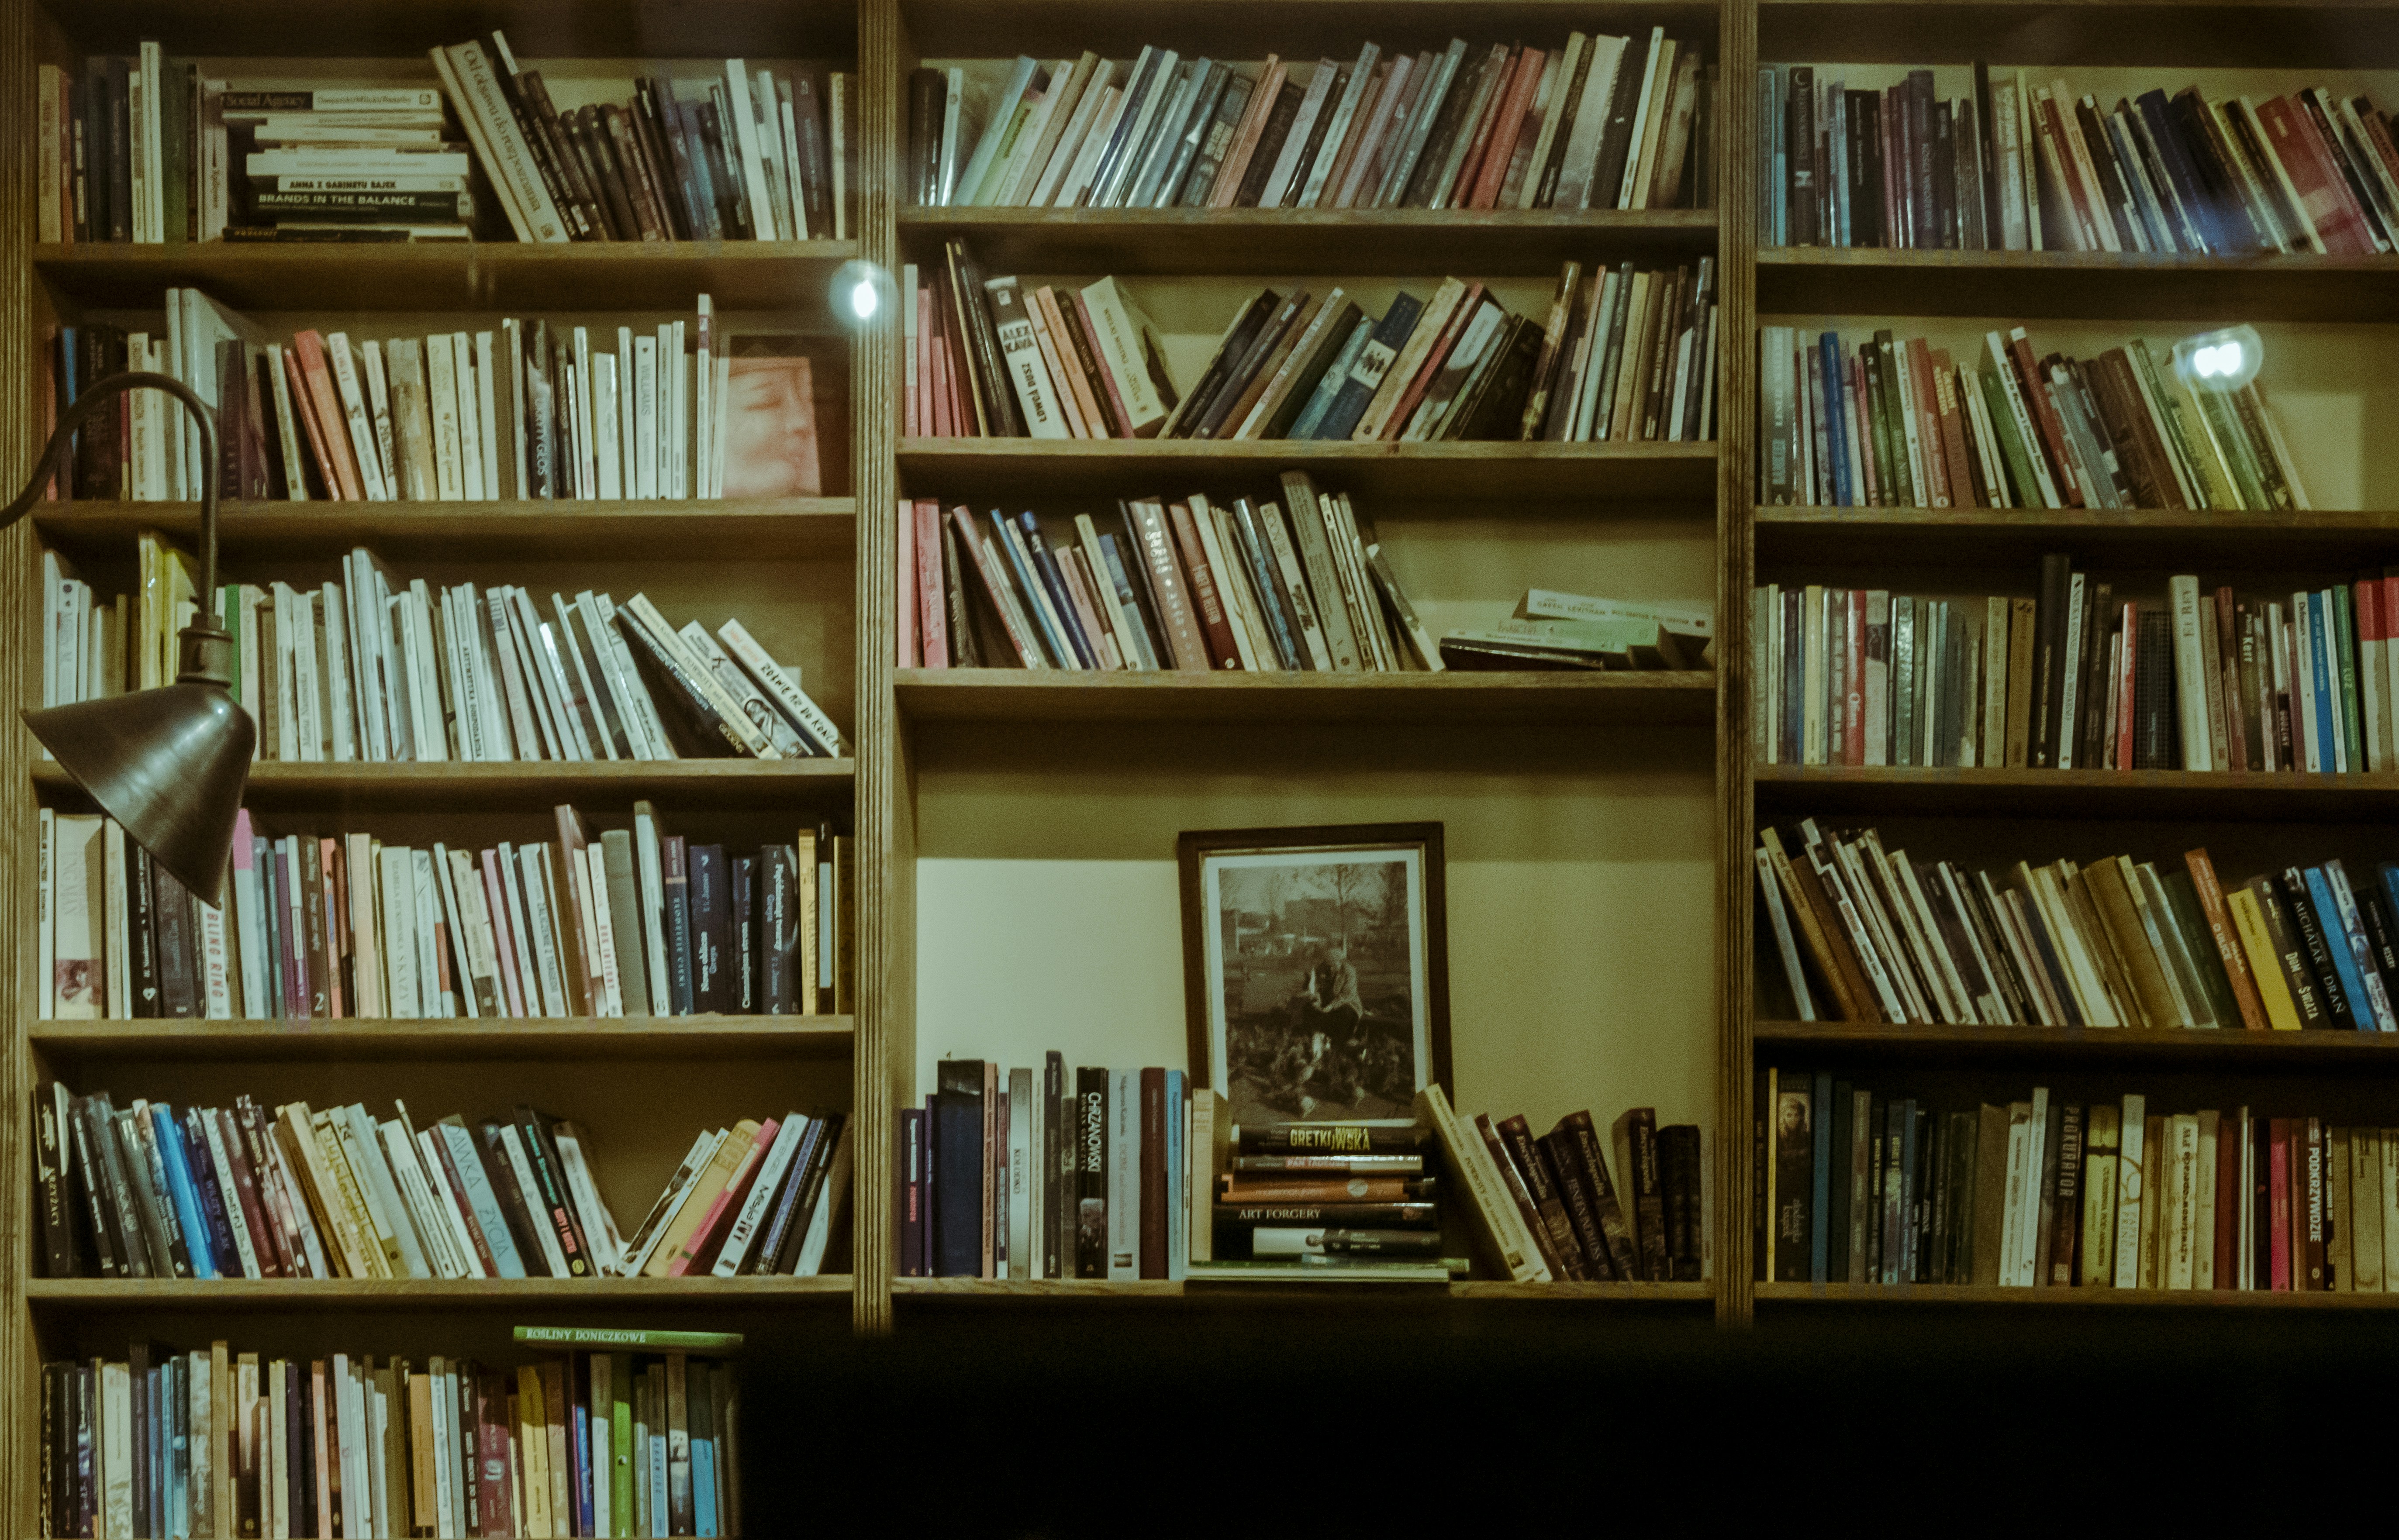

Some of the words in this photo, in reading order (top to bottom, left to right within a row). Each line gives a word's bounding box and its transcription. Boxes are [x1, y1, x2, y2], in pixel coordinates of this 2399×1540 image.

[463, 48, 483, 72] Od
[259, 195, 309, 204] BRANDS
[313, 196, 326, 204] IN
[331, 196, 354, 204] THE
[359, 196, 416, 206] BALANCE
[1001, 324, 1031, 341] ALEX
[1003, 336, 1035, 354] KAVA
[1021, 362, 1036, 387] DUSZ
[2243, 636, 2254, 662] Kerr
[206, 912, 221, 955] BLING
[2211, 922, 2222, 933] O
[2292, 900, 2326, 965] MICHALAK
[210, 962, 224, 998] RING
[314, 992, 325, 1011] 2
[1087, 1092, 1101, 1172] CHRZANOWSKI
[1638, 1126, 1652, 1194] Encyclopedia
[2058, 1106, 2080, 1197] PROKURATOR
[1464, 1155, 1487, 1195] POWROTY
[744, 1182, 770, 1222] Misja
[2308, 1147, 2321, 1242] PODKRZYWDZIE
[1239, 1209, 1263, 1219] ART
[1266, 1209, 1320, 1220] FORGERY
[575, 1330, 646, 1344] DONICZKOWE
